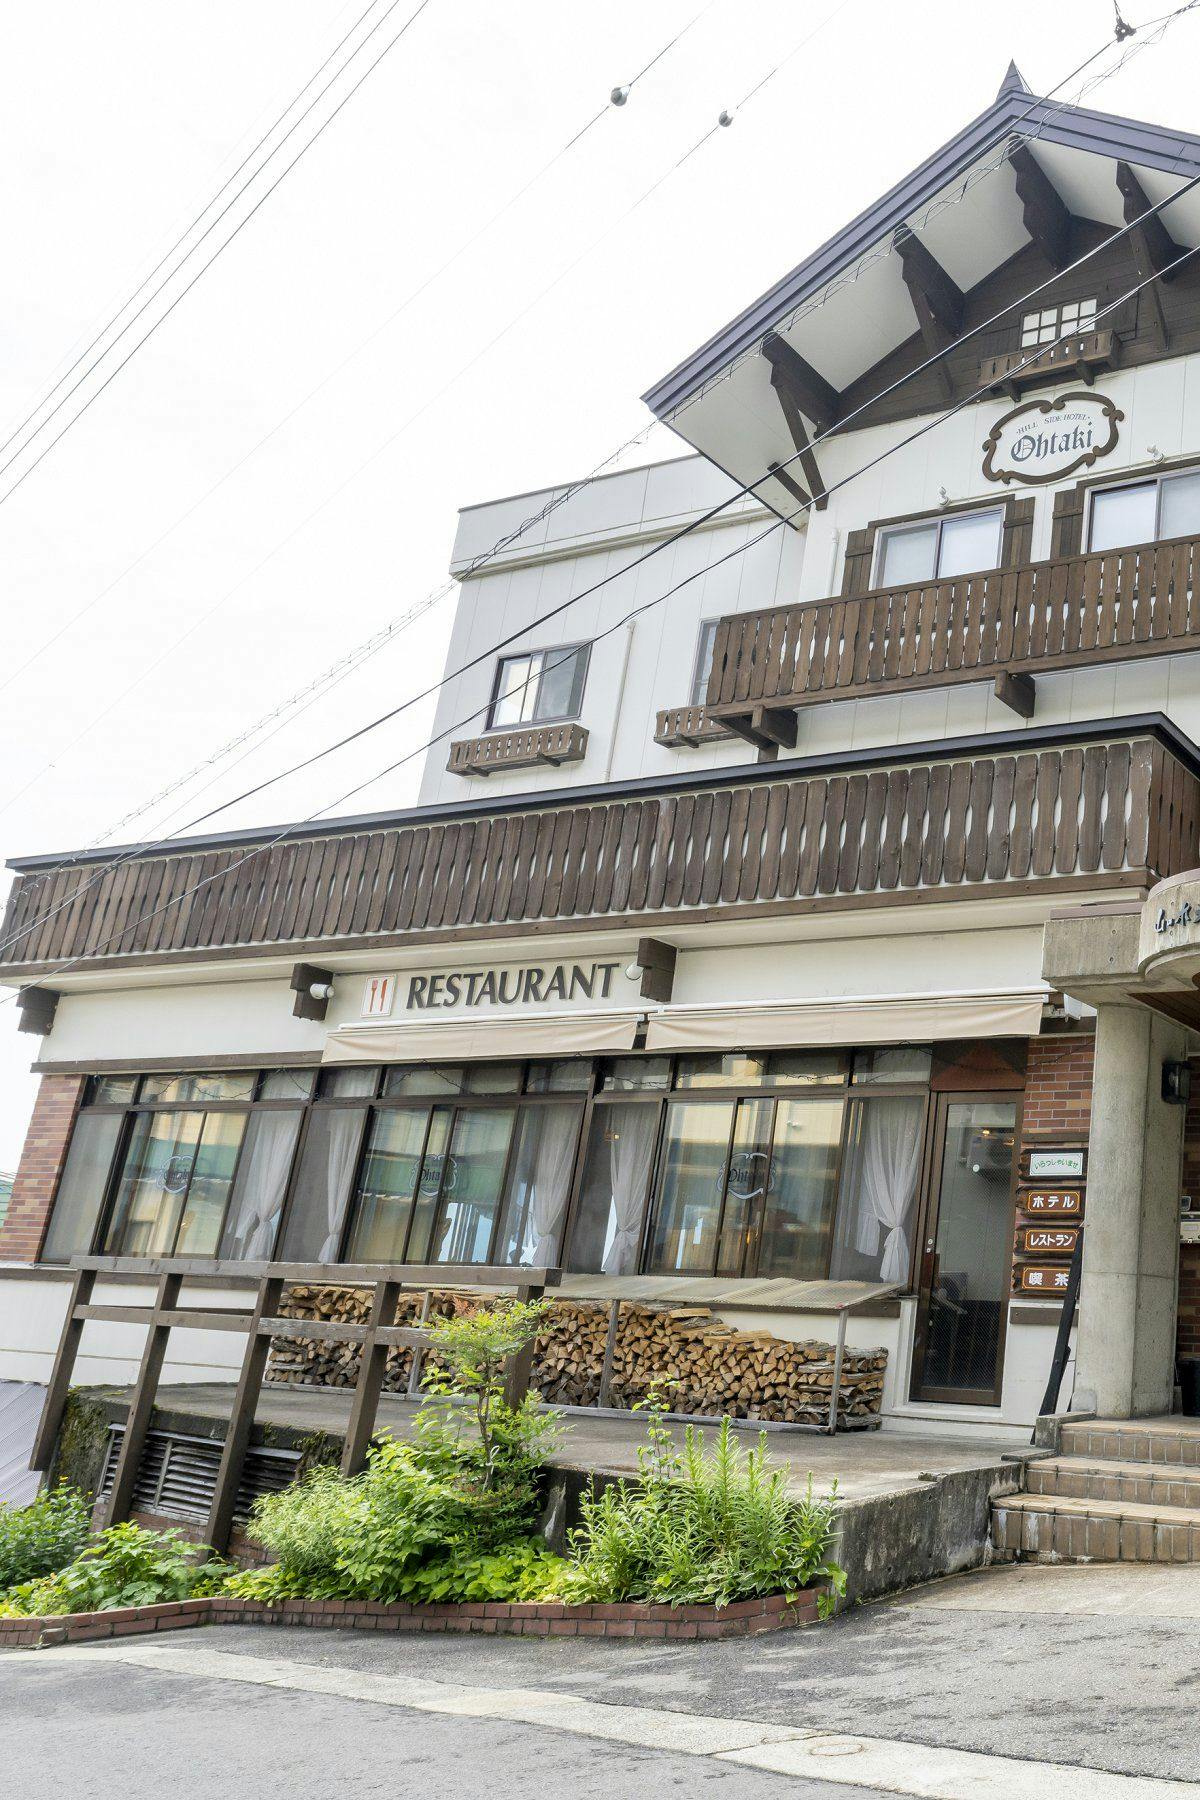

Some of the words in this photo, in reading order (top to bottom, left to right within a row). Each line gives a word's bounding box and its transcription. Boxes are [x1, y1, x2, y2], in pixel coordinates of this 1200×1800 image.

[1018, 422, 1038, 433] HILL
[1044, 416, 1061, 424] SIDE
[1063, 413, 1087, 421] HOTEL
[1010, 422, 1093, 462] Ohtaki
[406, 962, 620, 1010] RESTAURANT
[1032, 1195, 1075, 1208] ホテル
[1030, 1234, 1073, 1247] レストラン
[1028, 1272, 1069, 1288] 喫茶
